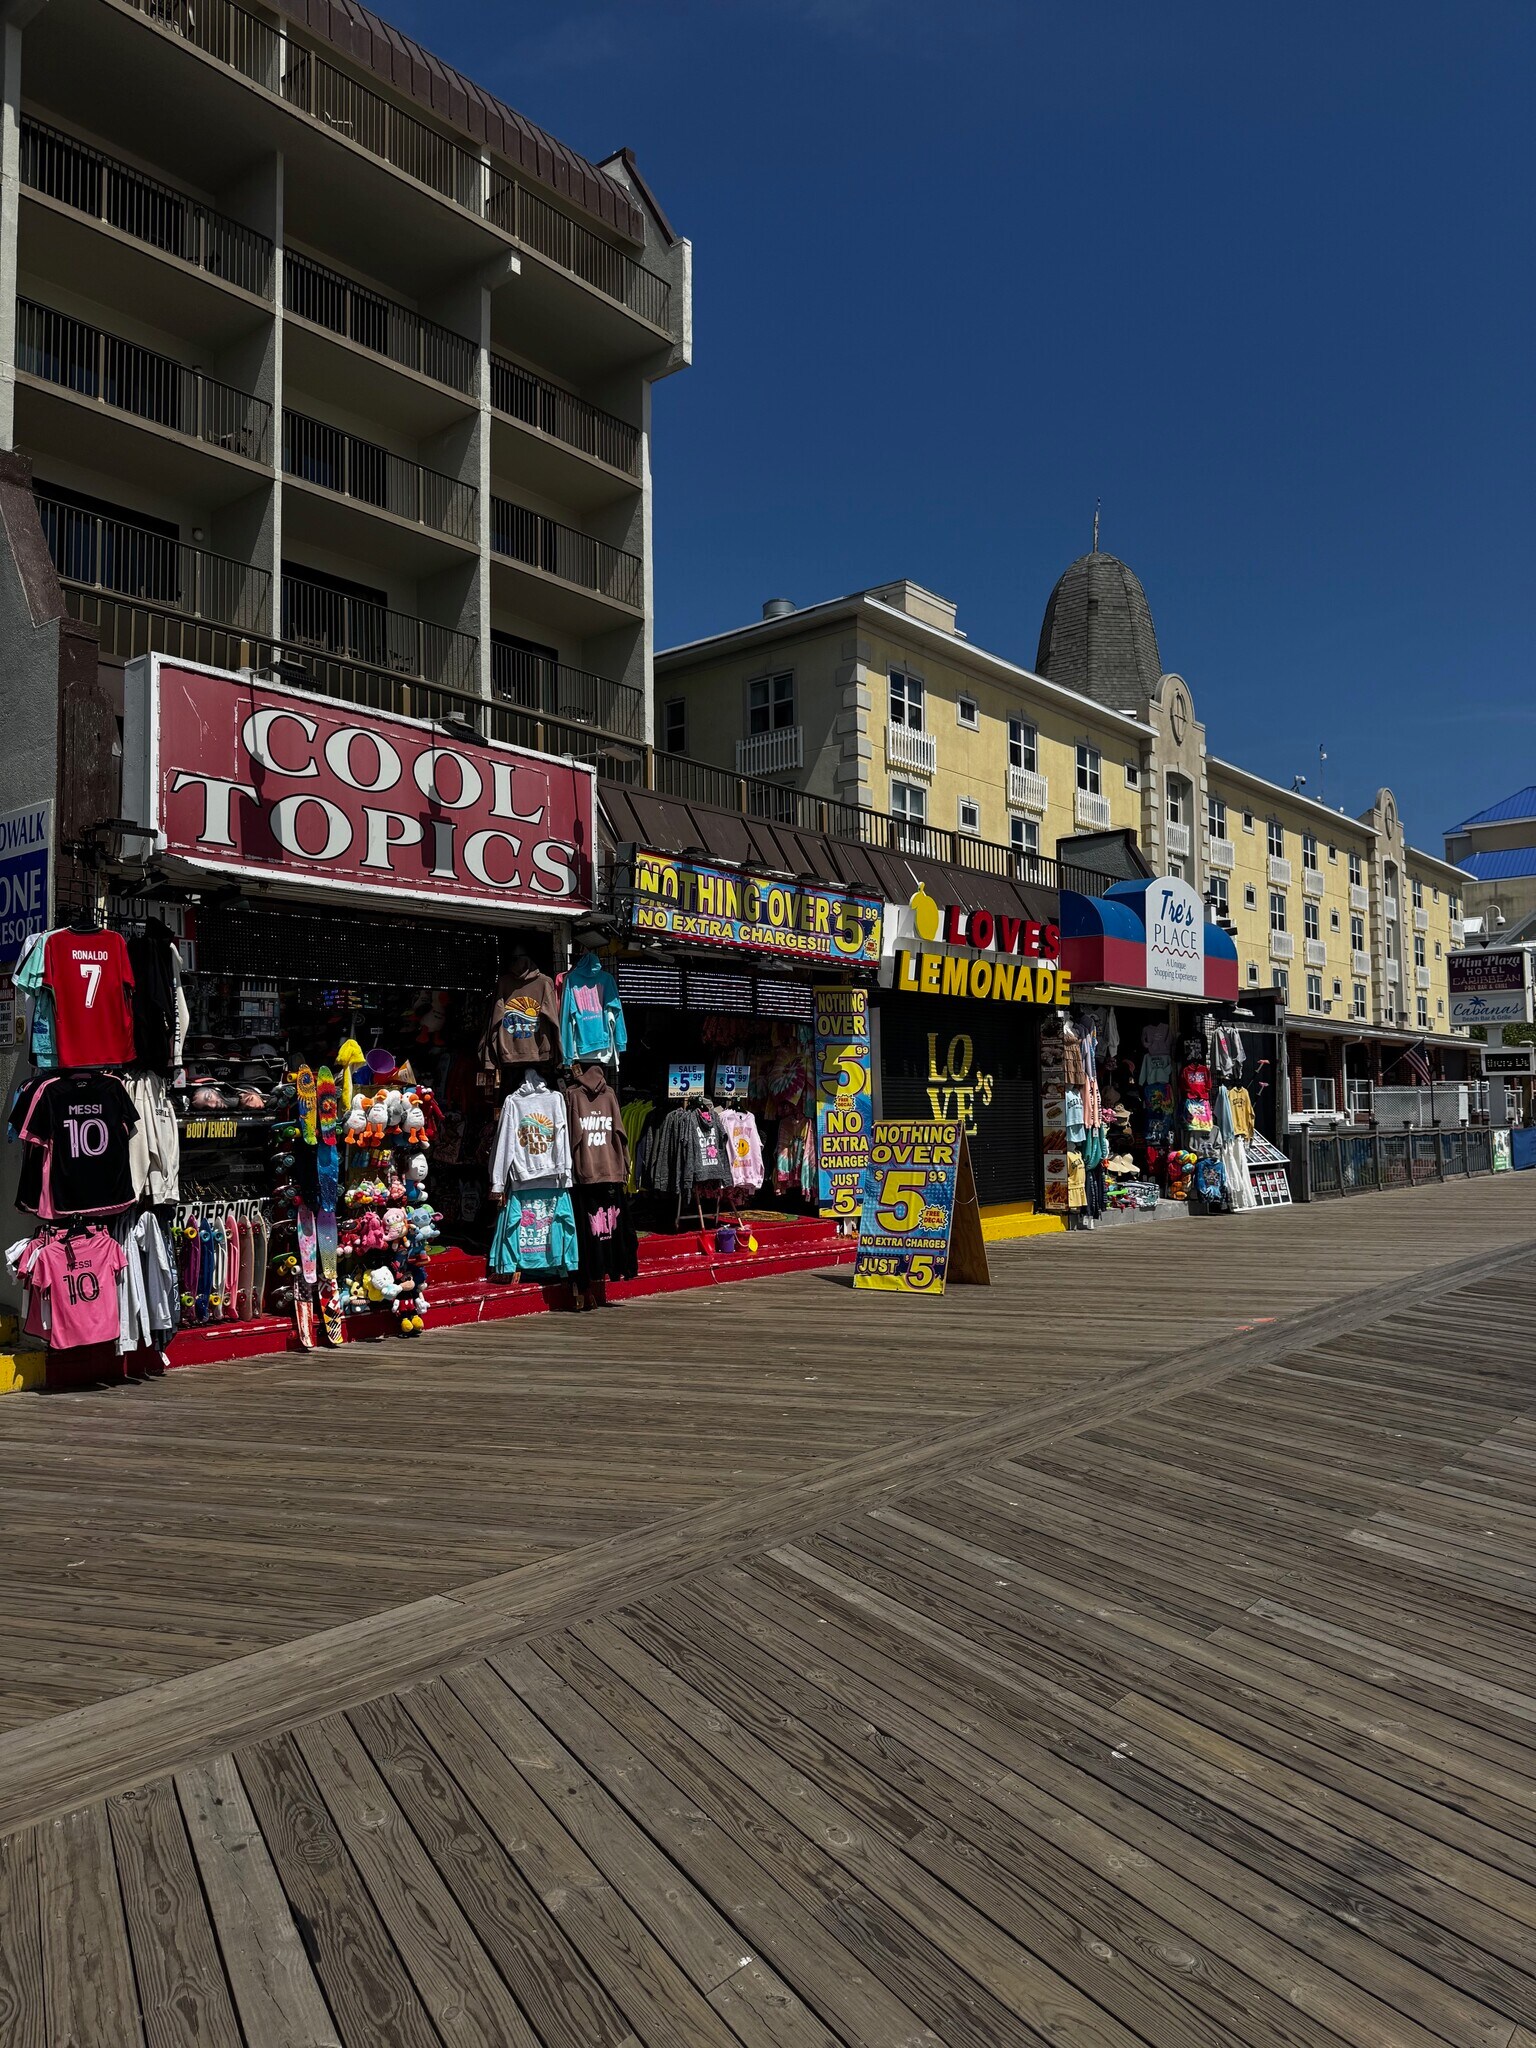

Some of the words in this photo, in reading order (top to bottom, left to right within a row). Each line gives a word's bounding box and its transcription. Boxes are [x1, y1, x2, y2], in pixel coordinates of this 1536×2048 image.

[242, 708, 545, 824] COOL
[171, 771, 579, 897] TOPICS
[639, 861, 760, 922] NOTHING
[768, 889, 831, 934] OVER
[1160, 889, 1194, 926] Tre's
[638, 909, 668, 927] NO
[672, 911, 734, 938] EXTRA
[739, 925, 831, 952] CHARGES!!!
[946, 905, 1061, 960] LOVES
[1154, 923, 1197, 950] PLACE
[72, 949, 109, 961] RONALDO
[1450, 957, 1482, 968] Plim
[1483, 955, 1520, 967] Plaza
[1171, 959, 1187, 971] Unique
[1467, 966, 1505, 975] HOTEL
[896, 950, 1072, 1005] LEMONADE
[1153, 966, 1175, 981] Shopping
[1175, 969, 1198, 983] Experience
[1452, 974, 1521, 986] CARIBBEAN
[80, 964, 102, 1008] 7
[818, 992, 865, 1014] NOTHING
[1453, 1003, 1524, 1016] Cabanas
[817, 1015, 866, 1036] OVER
[678, 1065, 697, 1073] SALE
[725, 1066, 742, 1074] SALE
[68, 1103, 102, 1115] MESSI
[186, 1123, 207, 1138] BODY
[207, 1121, 238, 1138] JEWELRY
[579, 1116, 613, 1131] WHITE
[827, 1112, 863, 1134] NO
[63, 1118, 110, 1158] 10
[588, 1132, 607, 1147] FOX
[874, 1126, 957, 1144] NOTHING
[822, 1137, 869, 1153] EXTRA
[820, 1155, 869, 1169] CHARGES
[871, 1145, 954, 1164] OVER
[831, 1173, 860, 1187] JUST
[861, 1237, 873, 1246] NO
[875, 1238, 903, 1247] EXTRA
[905, 1238, 947, 1249] CHARGES
[66, 1259, 92, 1271] MESSI
[858, 1258, 898, 1273] JUST
[63, 1272, 99, 1306] 10
